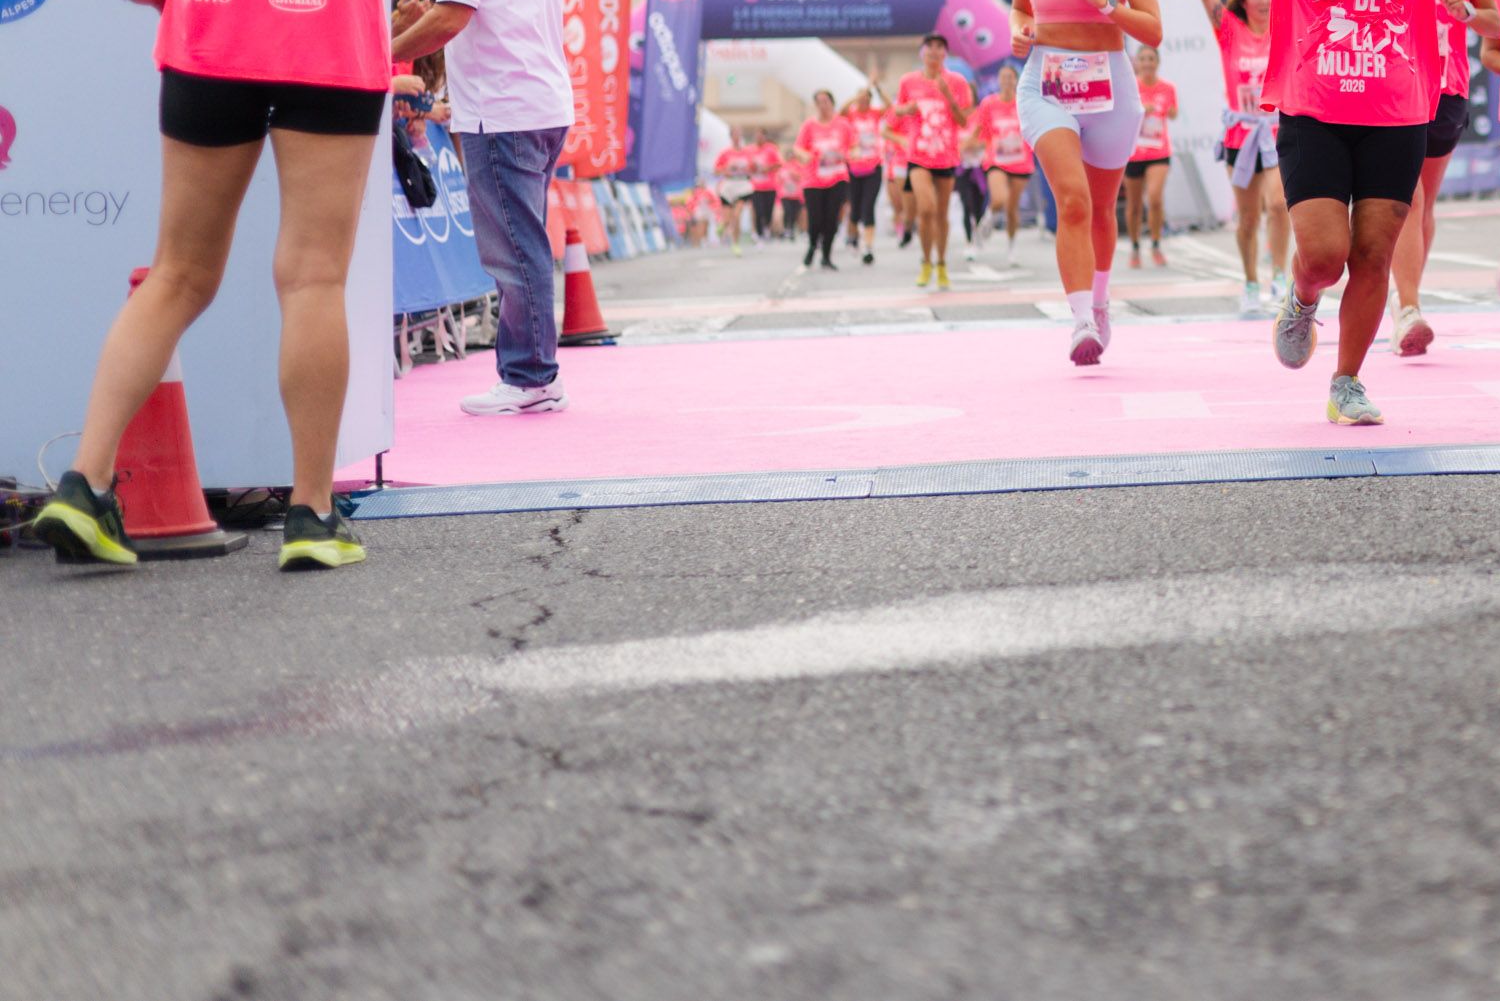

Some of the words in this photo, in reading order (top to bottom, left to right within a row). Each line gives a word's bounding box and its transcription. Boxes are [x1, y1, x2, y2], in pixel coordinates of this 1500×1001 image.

[1352, 24, 1374, 51] LA
[1316, 49, 1387, 78] MUJER
[1062, 81, 1090, 93] 016
[1340, 79, 1365, 93] 2026
[1, 189, 130, 226] energy
